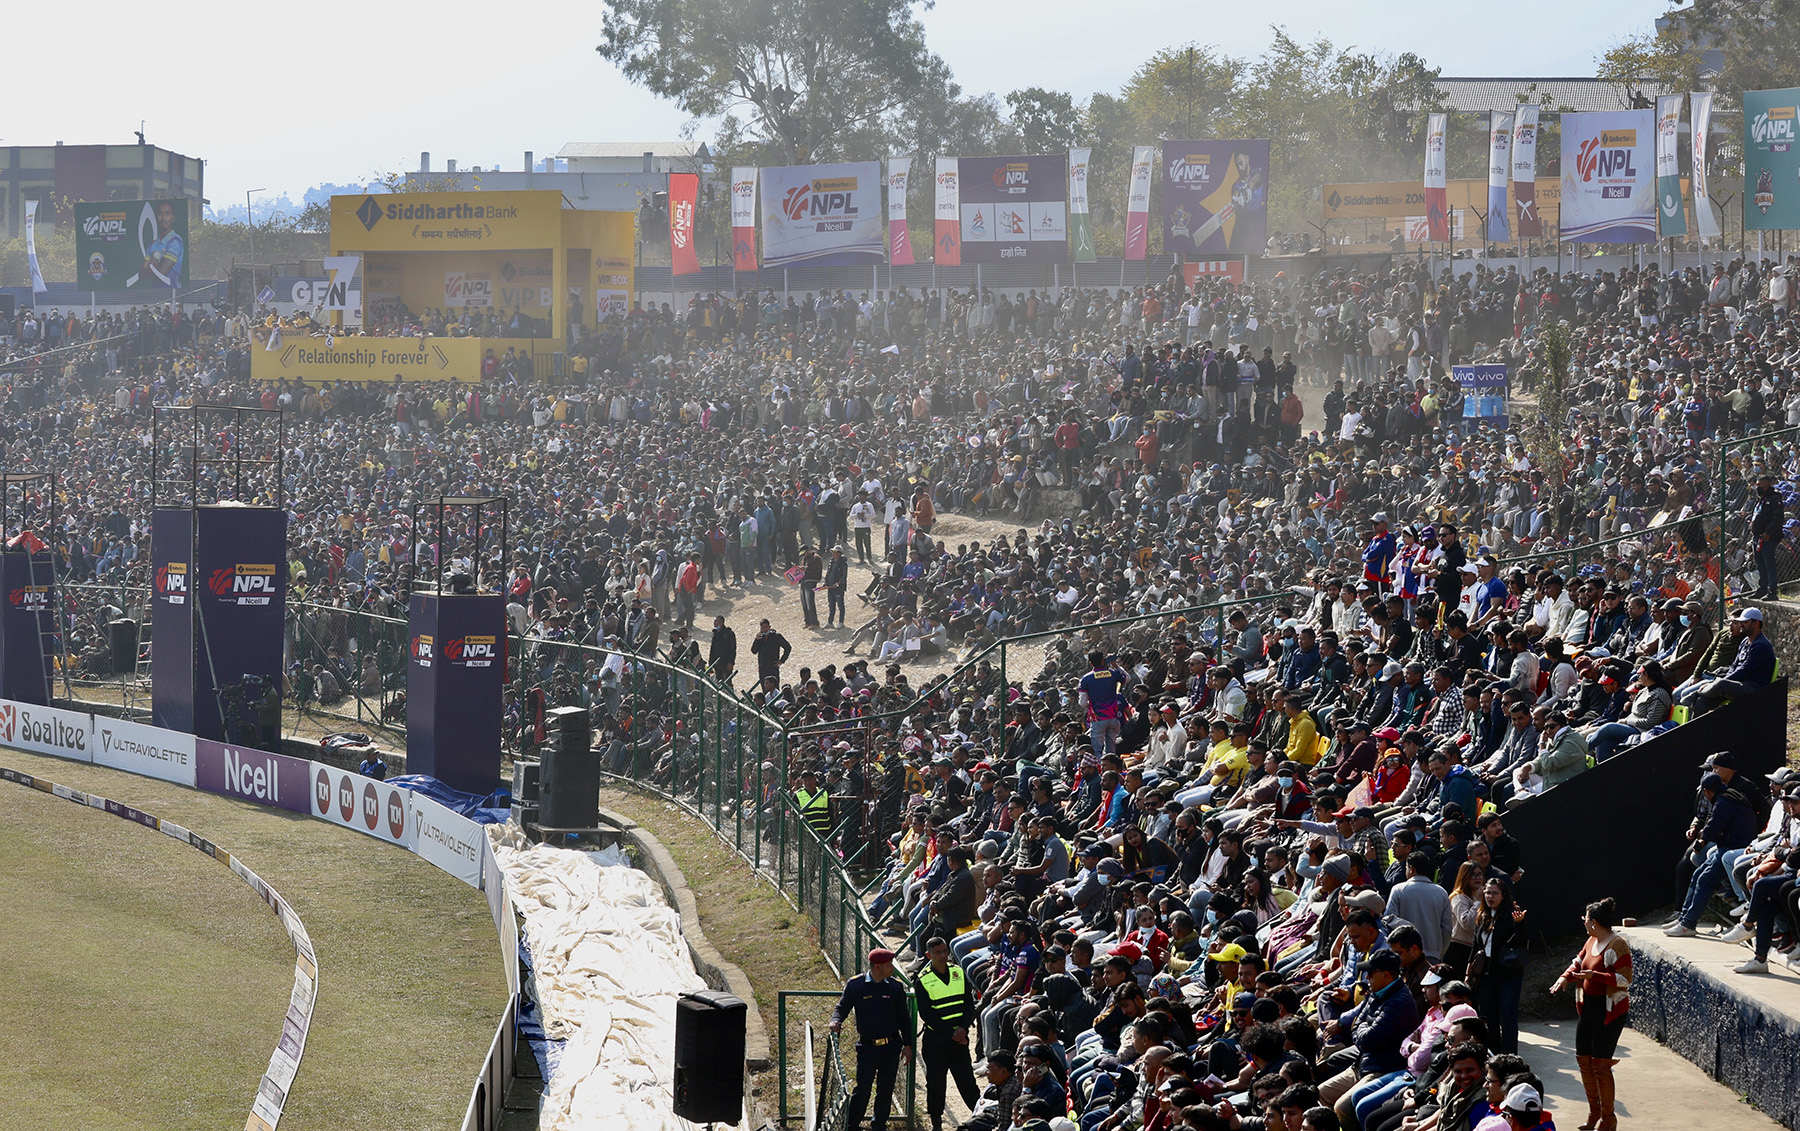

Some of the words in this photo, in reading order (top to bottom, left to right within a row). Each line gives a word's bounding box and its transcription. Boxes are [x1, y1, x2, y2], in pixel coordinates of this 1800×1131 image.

[1518, 129, 1534, 138] NPL
[1767, 120, 1795, 139] NPL
[1774, 144, 1786, 152] Ncell
[1598, 150, 1636, 177] NPL
[1006, 172, 1029, 184] NPL
[1184, 165, 1210, 179] NPL
[1609, 187, 1624, 198] Ncell
[810, 193, 858, 216] NPL
[1344, 196, 1390, 206] Siddhartha
[1405, 194, 1425, 205] ZON
[386, 203, 485, 220] Siddhartha
[486, 205, 517, 218] Bank
[676, 200, 686, 230] NPL
[99, 220, 126, 233] NPL
[824, 222, 844, 231] Ncell
[598, 275, 610, 284] VIP
[611, 275, 627, 285] BOX
[462, 281, 491, 295] NPL
[502, 288, 534, 306] VIP
[324, 338, 333, 347] 6
[298, 349, 376, 368] Relationship
[381, 350, 429, 364] Forever
[1453, 370, 1474, 381] vivo
[1477, 372, 1504, 381] vivo
[167, 574, 187, 592] NPL
[233, 576, 276, 592] NPL
[24, 592, 48, 603] NPL
[419, 643, 433, 658] NPL
[463, 645, 495, 658] NPL
[21, 711, 86, 751] Soaltee
[113, 738, 188, 765] ULTRAVIOLETTE
[224, 748, 279, 802] Ncell
[908, 772, 922, 793] 6
[423, 821, 476, 862] ULTRAVIOLETTE
